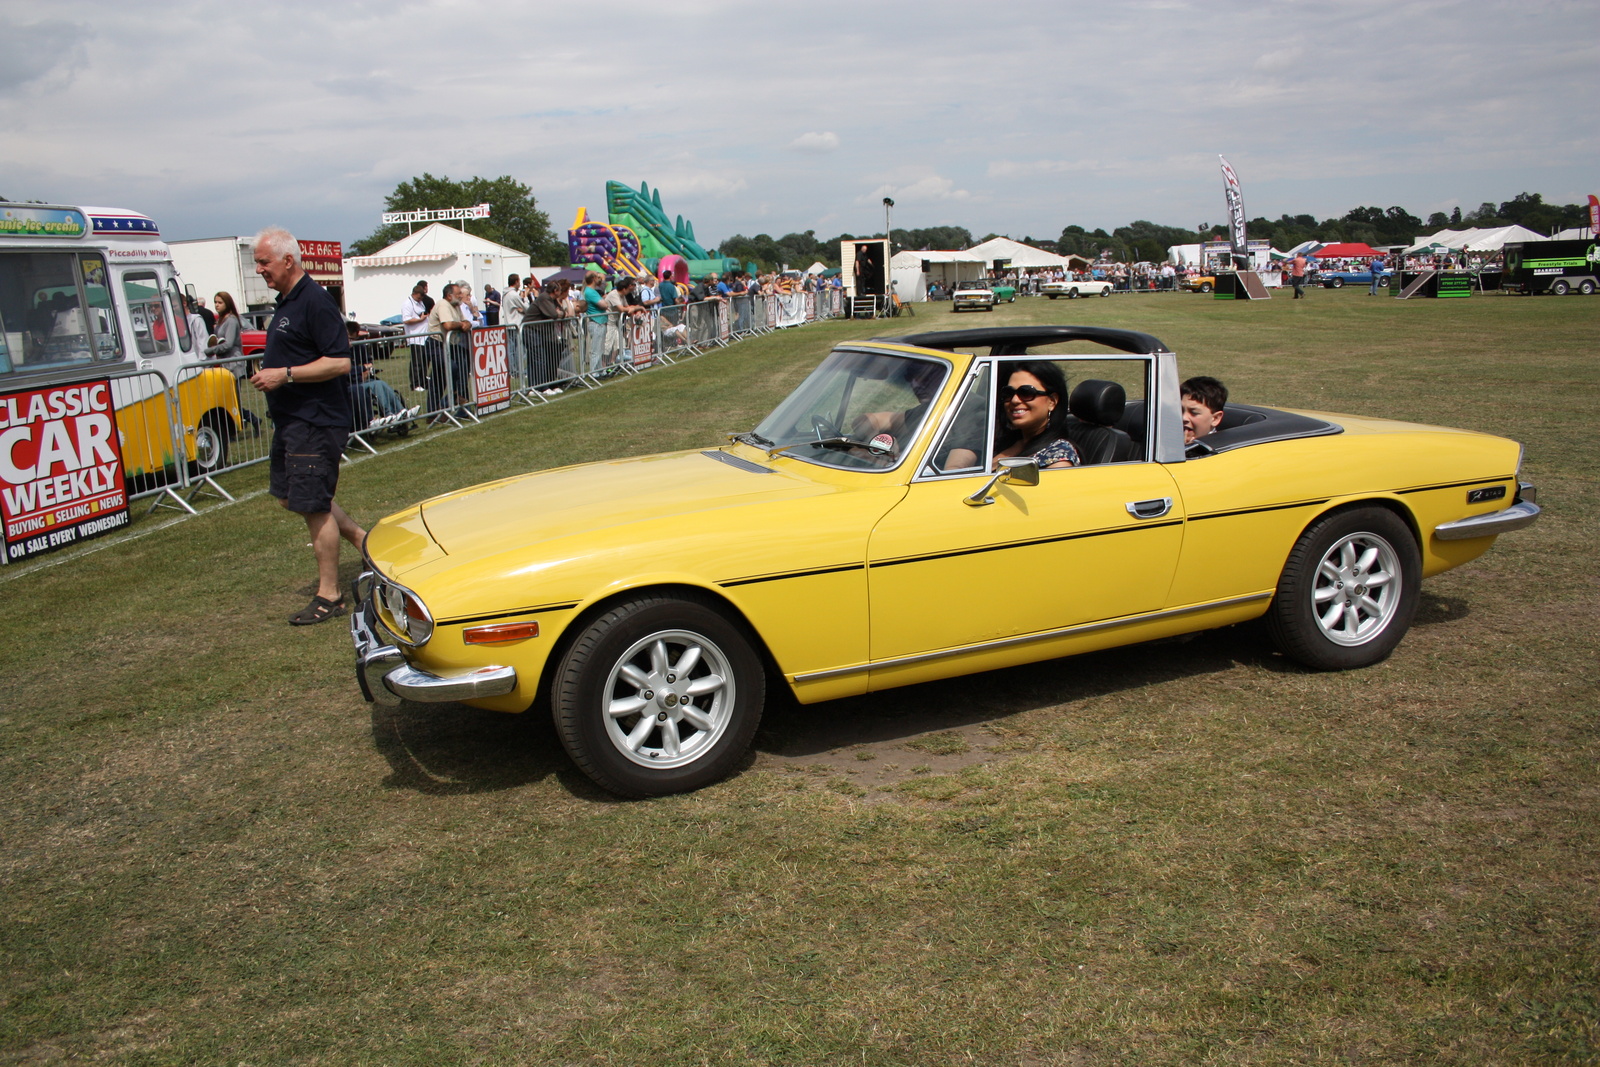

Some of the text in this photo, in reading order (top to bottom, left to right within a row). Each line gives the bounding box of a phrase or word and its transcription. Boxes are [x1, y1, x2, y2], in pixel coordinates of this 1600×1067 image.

[26, 218, 42, 231] ice
[44, 222, 80, 232] cream
[109, 249, 168, 258] Piccadilly Whip
[317, 243, 333, 256] BAR
[473, 329, 505, 347] CLASSIC
[633, 323, 651, 345] CAR
[474, 344, 508, 377] CAR
[477, 372, 508, 394] WEEKLY
[0, 413, 118, 486] CAR
[2, 462, 118, 517] WEEKLY
[8, 494, 124, 538] BUYING SELLING NEWS
[10, 511, 128, 558] ON SALE EVERY WEDNESDAY!
